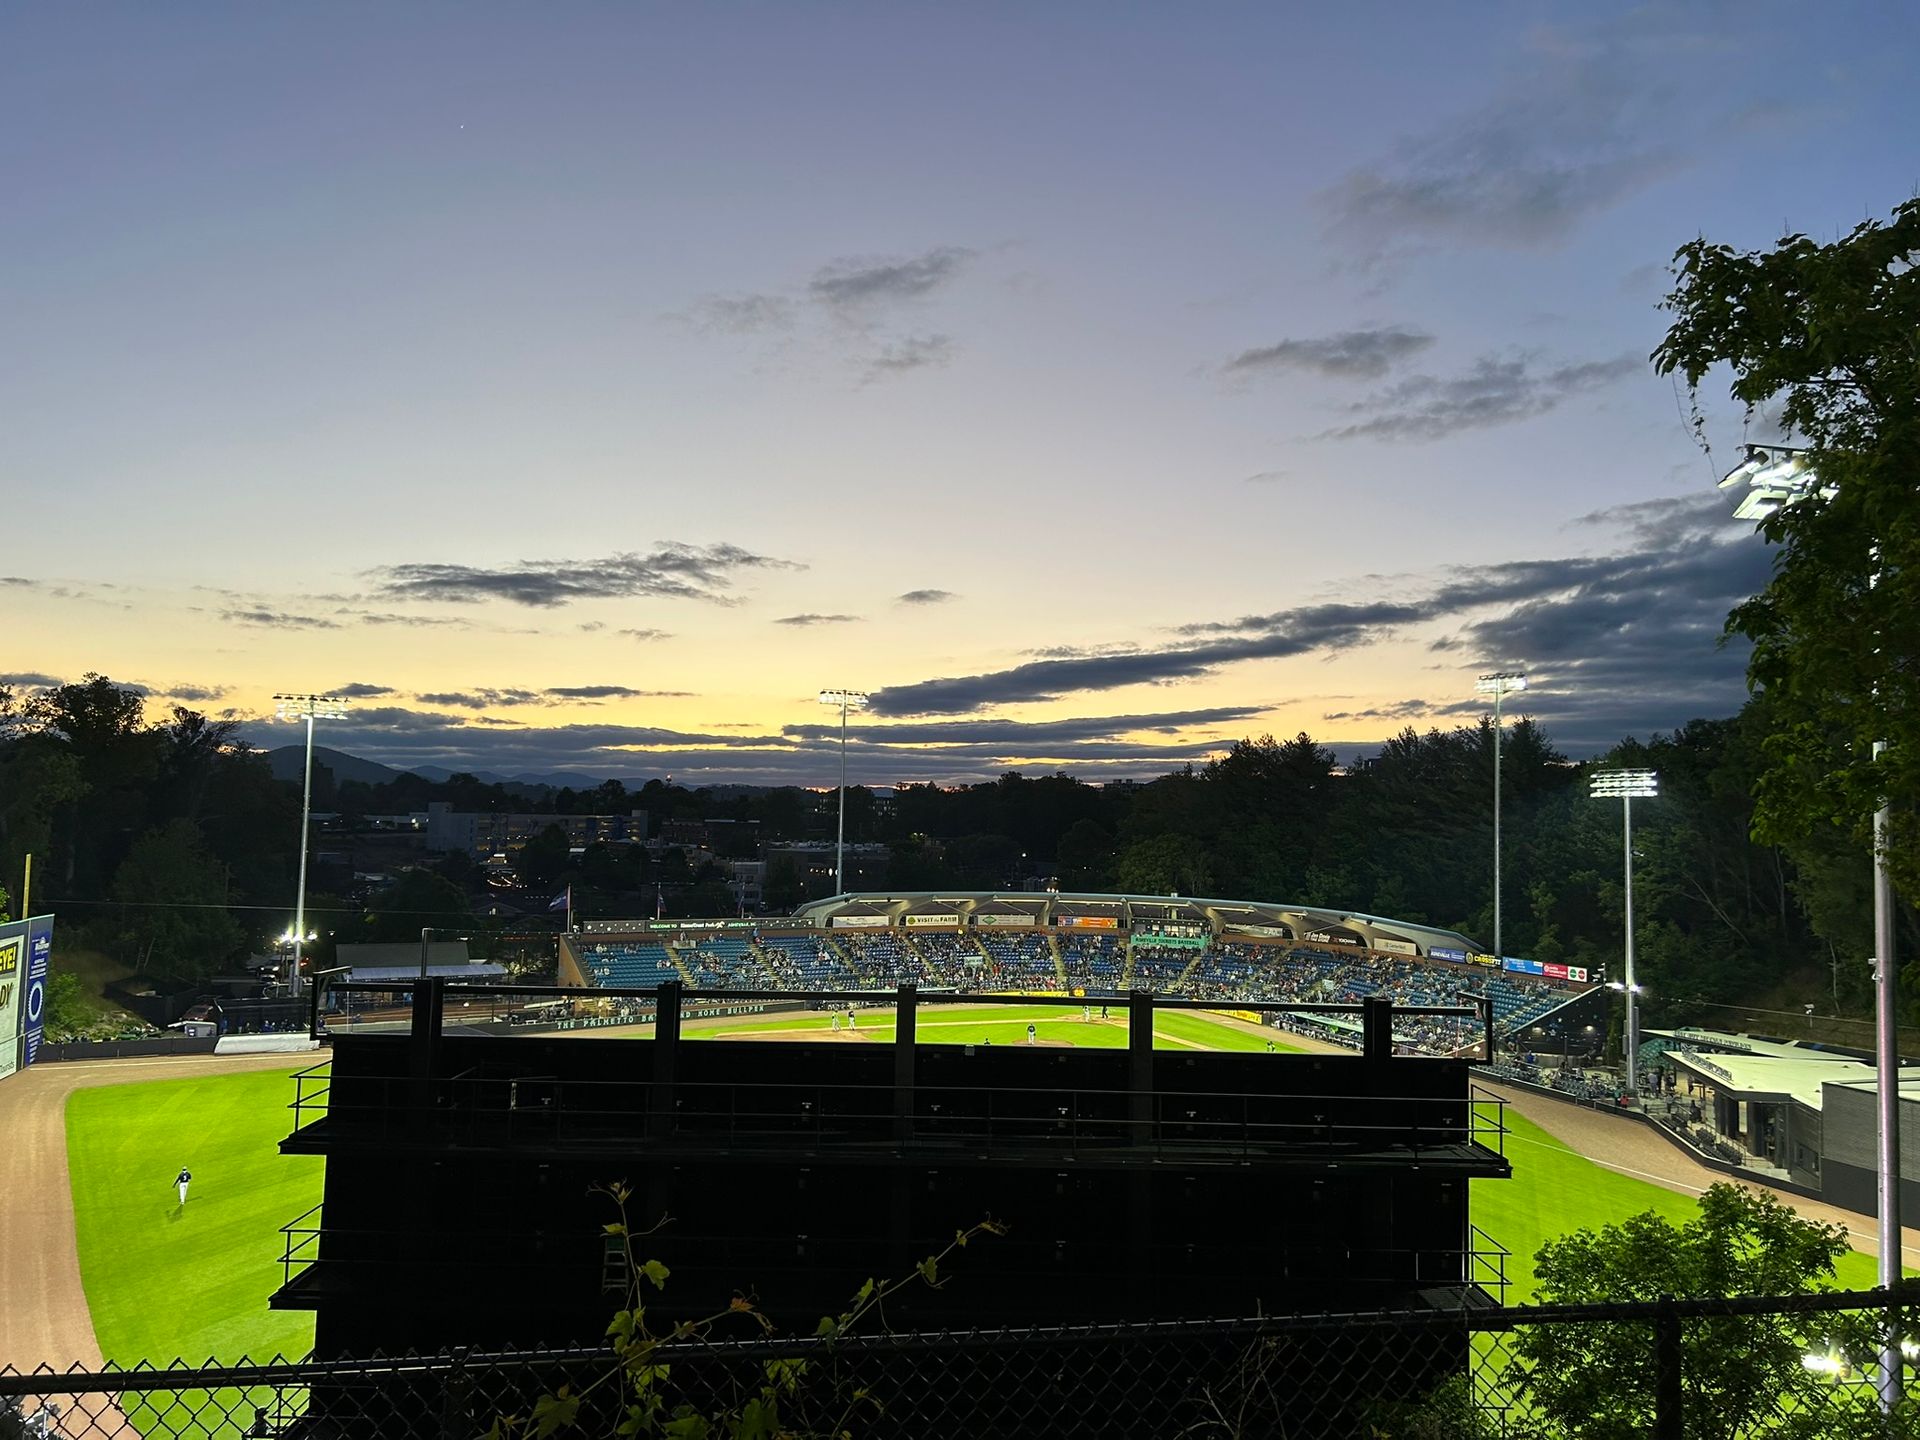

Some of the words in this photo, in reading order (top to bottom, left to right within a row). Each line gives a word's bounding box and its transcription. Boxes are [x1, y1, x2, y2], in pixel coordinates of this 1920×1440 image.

[557, 1021, 575, 1030] THE
[583, 1016, 634, 1027] PALMETTO
[698, 1008, 720, 1017] HOME
[727, 1005, 764, 1015] BULLPEN
